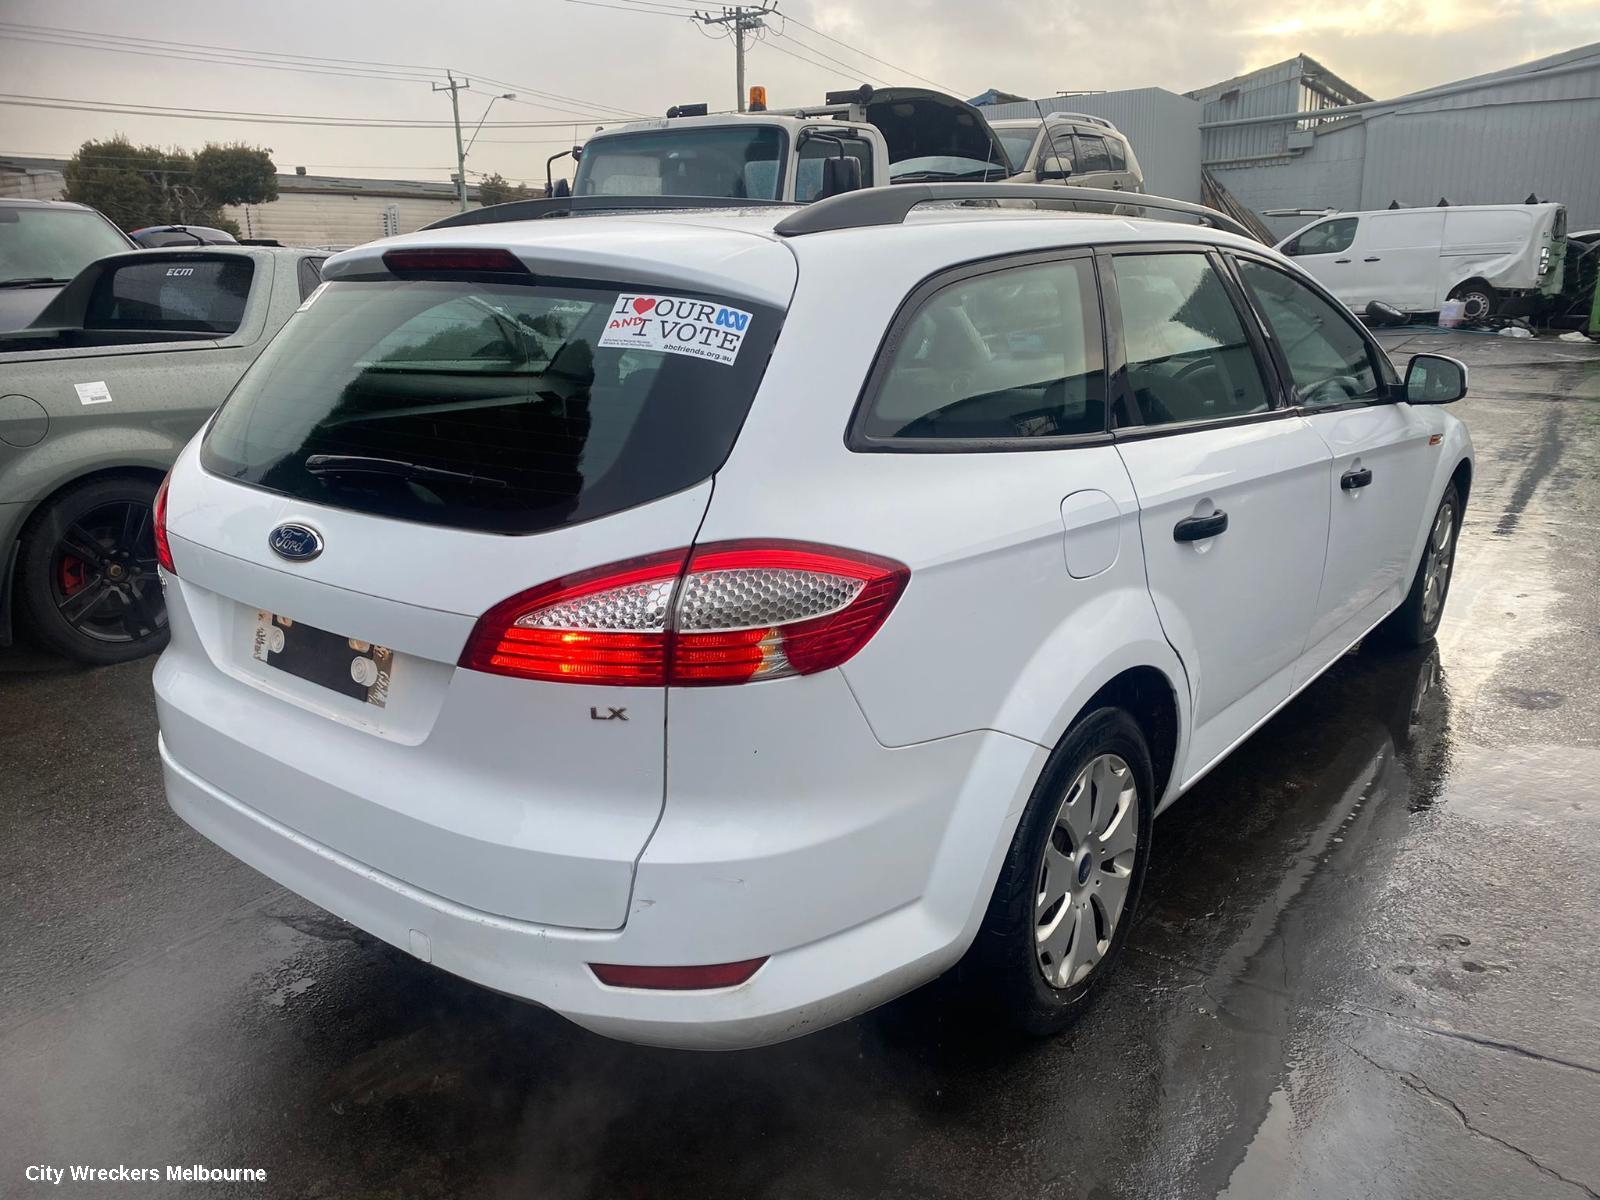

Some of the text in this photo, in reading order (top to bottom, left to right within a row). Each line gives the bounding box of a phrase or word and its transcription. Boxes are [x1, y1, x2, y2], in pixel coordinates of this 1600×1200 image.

[616, 297, 716, 324] I OUR
[609, 316, 741, 352] AND I VOTE
[663, 343, 732, 362] abcfriends.org.au
[275, 527, 310, 553] Ford
[590, 706, 630, 721] LX
